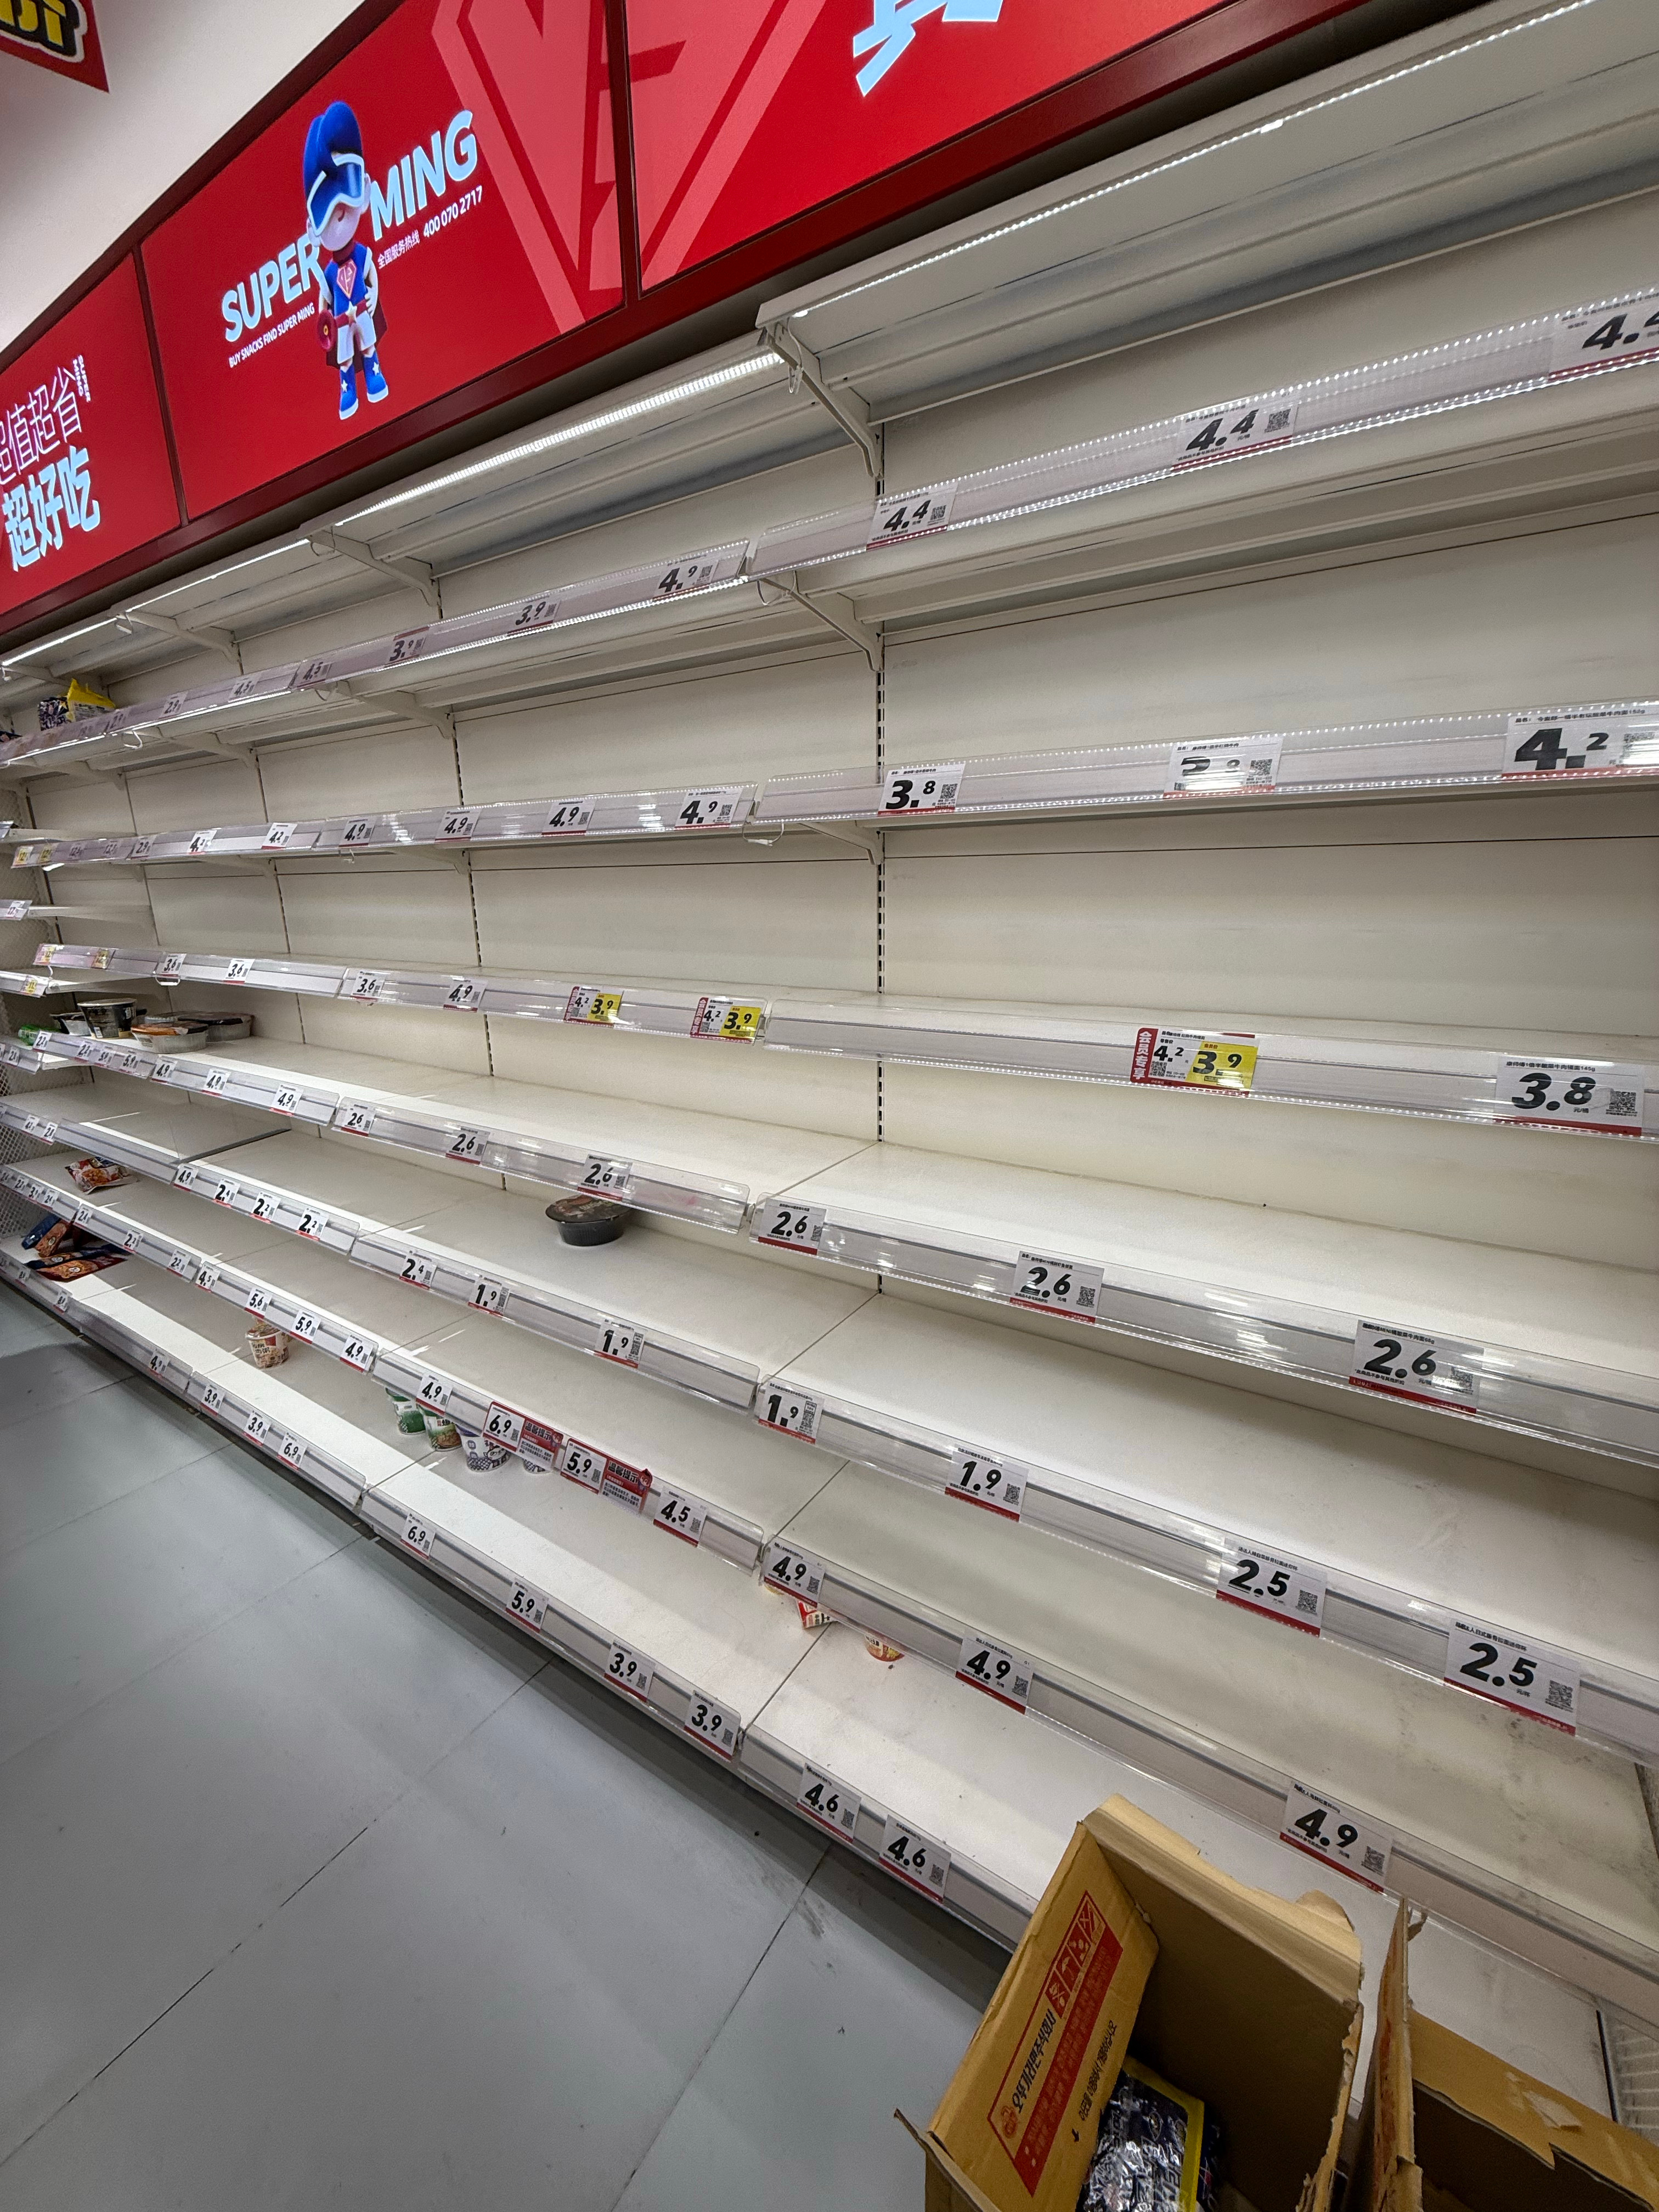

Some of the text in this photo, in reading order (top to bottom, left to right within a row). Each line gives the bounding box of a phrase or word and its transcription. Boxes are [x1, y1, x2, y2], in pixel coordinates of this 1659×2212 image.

[370, 109, 477, 241] MING
[377, 185, 482, 269] 全国服务热线 400 070 2717
[222, 233, 327, 342] SUPER
[228, 302, 315, 368] BUY SNACKS FIND SUPER MING
[72, 358, 83, 397] MING
[78, 354, 91, 402] SUPER
[1186, 409, 1259, 451] 4.4
[2, 445, 100, 572] 超好吃
[883, 500, 931, 532] 4.4
[659, 565, 698, 592] 4.9
[516, 601, 546, 625] 3.9
[389, 640, 414, 662] 3.9
[1514, 728, 1609, 770] 4.2
[885, 780, 936, 809] 3.8
[549, 806, 580, 827] 4.9
[680, 800, 718, 824] 4.9
[344, 823, 365, 842] 4.9
[444, 817, 469, 834] 4.9
[163, 958, 177, 972] 3.6
[228, 963, 245, 977] 3.6
[357, 978, 377, 993] 3.6
[448, 984, 473, 1002] 4.9
[574, 996, 589, 1008] 4.2
[590, 998, 614, 1015] 3.9
[703, 1010, 721, 1022] 4.2
[724, 1012, 752, 1030] 3.9
[1133, 1031, 1153, 1080] 会员专享
[1154, 1046, 1184, 1062] 4.2
[156, 1063, 170, 1076] 4.9
[206, 1075, 222, 1090] 4.9
[1511, 1073, 1596, 1111] 3.8
[277, 1092, 294, 1107] 4.9
[347, 1113, 364, 1126] 2.6
[452, 1133, 475, 1153] 2.6
[178, 1170, 192, 1183] 4.9
[584, 1163, 613, 1185] 2.6
[215, 1183, 231, 1201] 2.4
[252, 1198, 270, 1216] 2.2
[298, 1214, 318, 1234] 2.2
[771, 1211, 808, 1237] 2.6
[198, 1270, 212, 1287] 4.5
[402, 1257, 425, 1280] 2.4
[1020, 1266, 1072, 1298] 2.6
[249, 1293, 263, 1308] 5.6
[475, 1283, 498, 1307] 1.9
[295, 1316, 313, 1333] 5.9
[345, 1341, 364, 1359] 4.9
[602, 1329, 629, 1356] 1.9
[1363, 1339, 1437, 1379] 2.6
[204, 1389, 218, 1404] 3.9
[421, 1381, 442, 1400] 4.9
[767, 1394, 799, 1427] 1.9
[248, 1417, 263, 1433] 3.9
[489, 1414, 512, 1435] 6.9
[283, 1442, 299, 1458] 6.9
[567, 1451, 592, 1475] 5.9
[607, 1460, 639, 1483] 温馨提示
[960, 1460, 1002, 1492] 1.9
[661, 1499, 691, 1523] 4.5
[408, 1526, 426, 1543] 6.9
[772, 1556, 806, 1582] 4.9
[1228, 1559, 1291, 1598] 2.5
[511, 1590, 535, 1613] 5.9
[609, 1652, 637, 1678] 3.9
[967, 1650, 1011, 1680] 4.9
[1459, 1643, 1538, 1687] 2.5
[691, 1704, 723, 1732] 3.9
[804, 1782, 840, 1813] 4.6
[1294, 1808, 1358, 1848] 4.9
[887, 1835, 927, 1868] 4.6
[1012, 2007, 1057, 2113] 오뚜기라면주식회사
